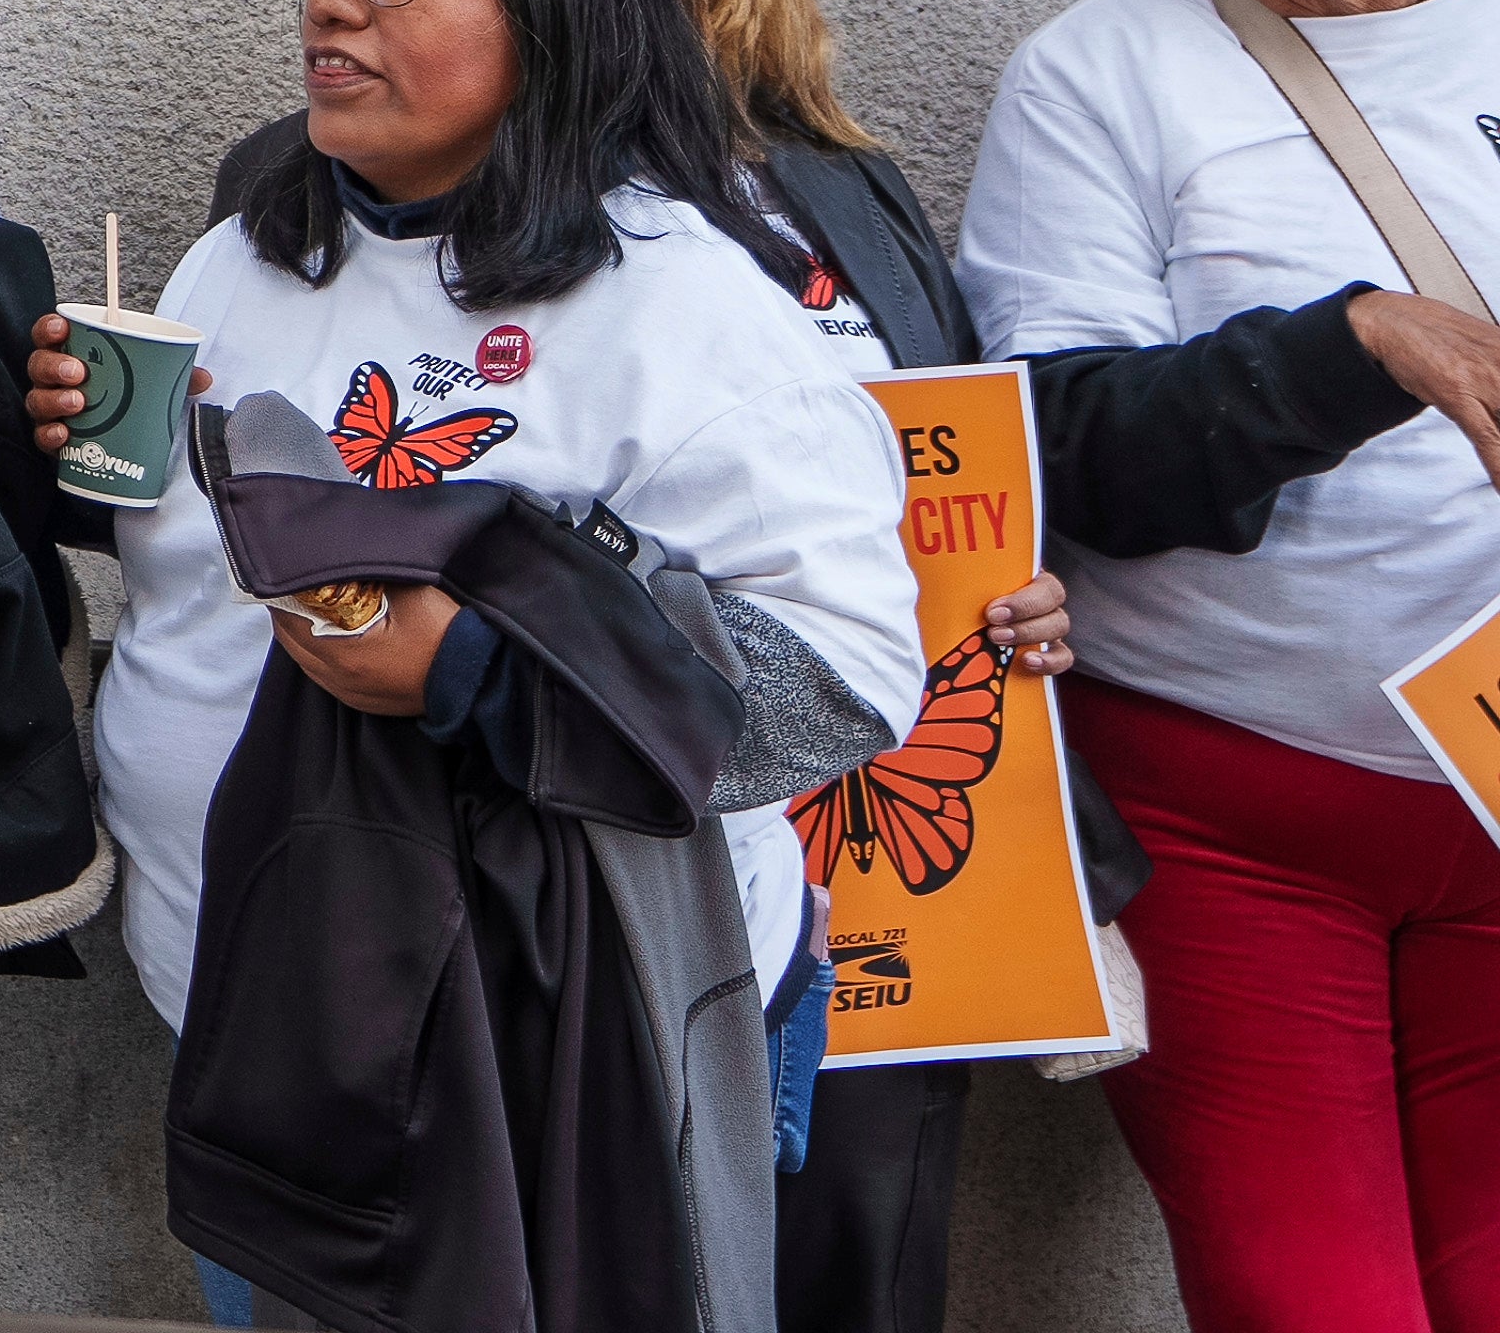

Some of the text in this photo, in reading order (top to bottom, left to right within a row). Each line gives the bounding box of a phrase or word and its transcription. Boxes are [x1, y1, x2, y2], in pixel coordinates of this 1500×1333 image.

[486, 335, 523, 347] UNITE
[485, 348, 521, 362] HERE!
[412, 372, 455, 402] OUR
[104, 454, 145, 481] YUM
[910, 491, 1009, 555] CITY
[827, 927, 907, 945] LOCAL 721
[833, 982, 912, 1012] SEIU
